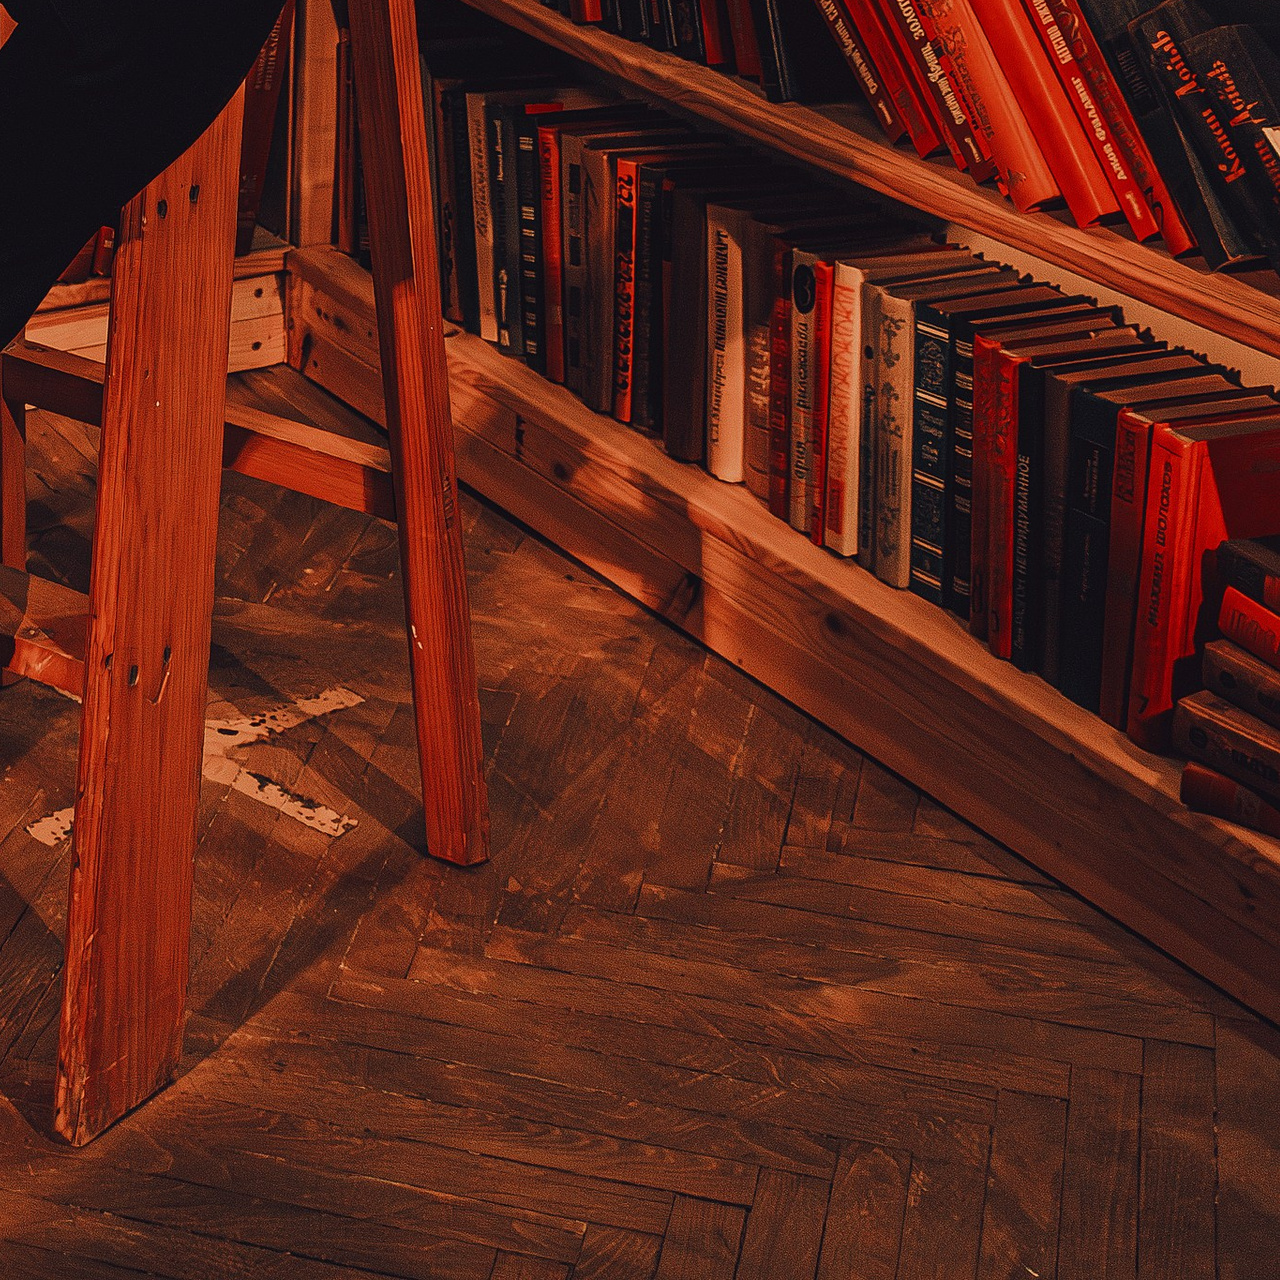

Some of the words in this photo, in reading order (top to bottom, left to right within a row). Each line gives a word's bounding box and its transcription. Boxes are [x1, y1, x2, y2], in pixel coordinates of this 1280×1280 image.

[1146, 26, 1205, 102] Дойль
[1191, 107, 1247, 183] Конан
[1017, 455, 1028, 575] НЕПРИДУМАННОЕ
[1155, 462, 1172, 548] ШОЛОХОВ
